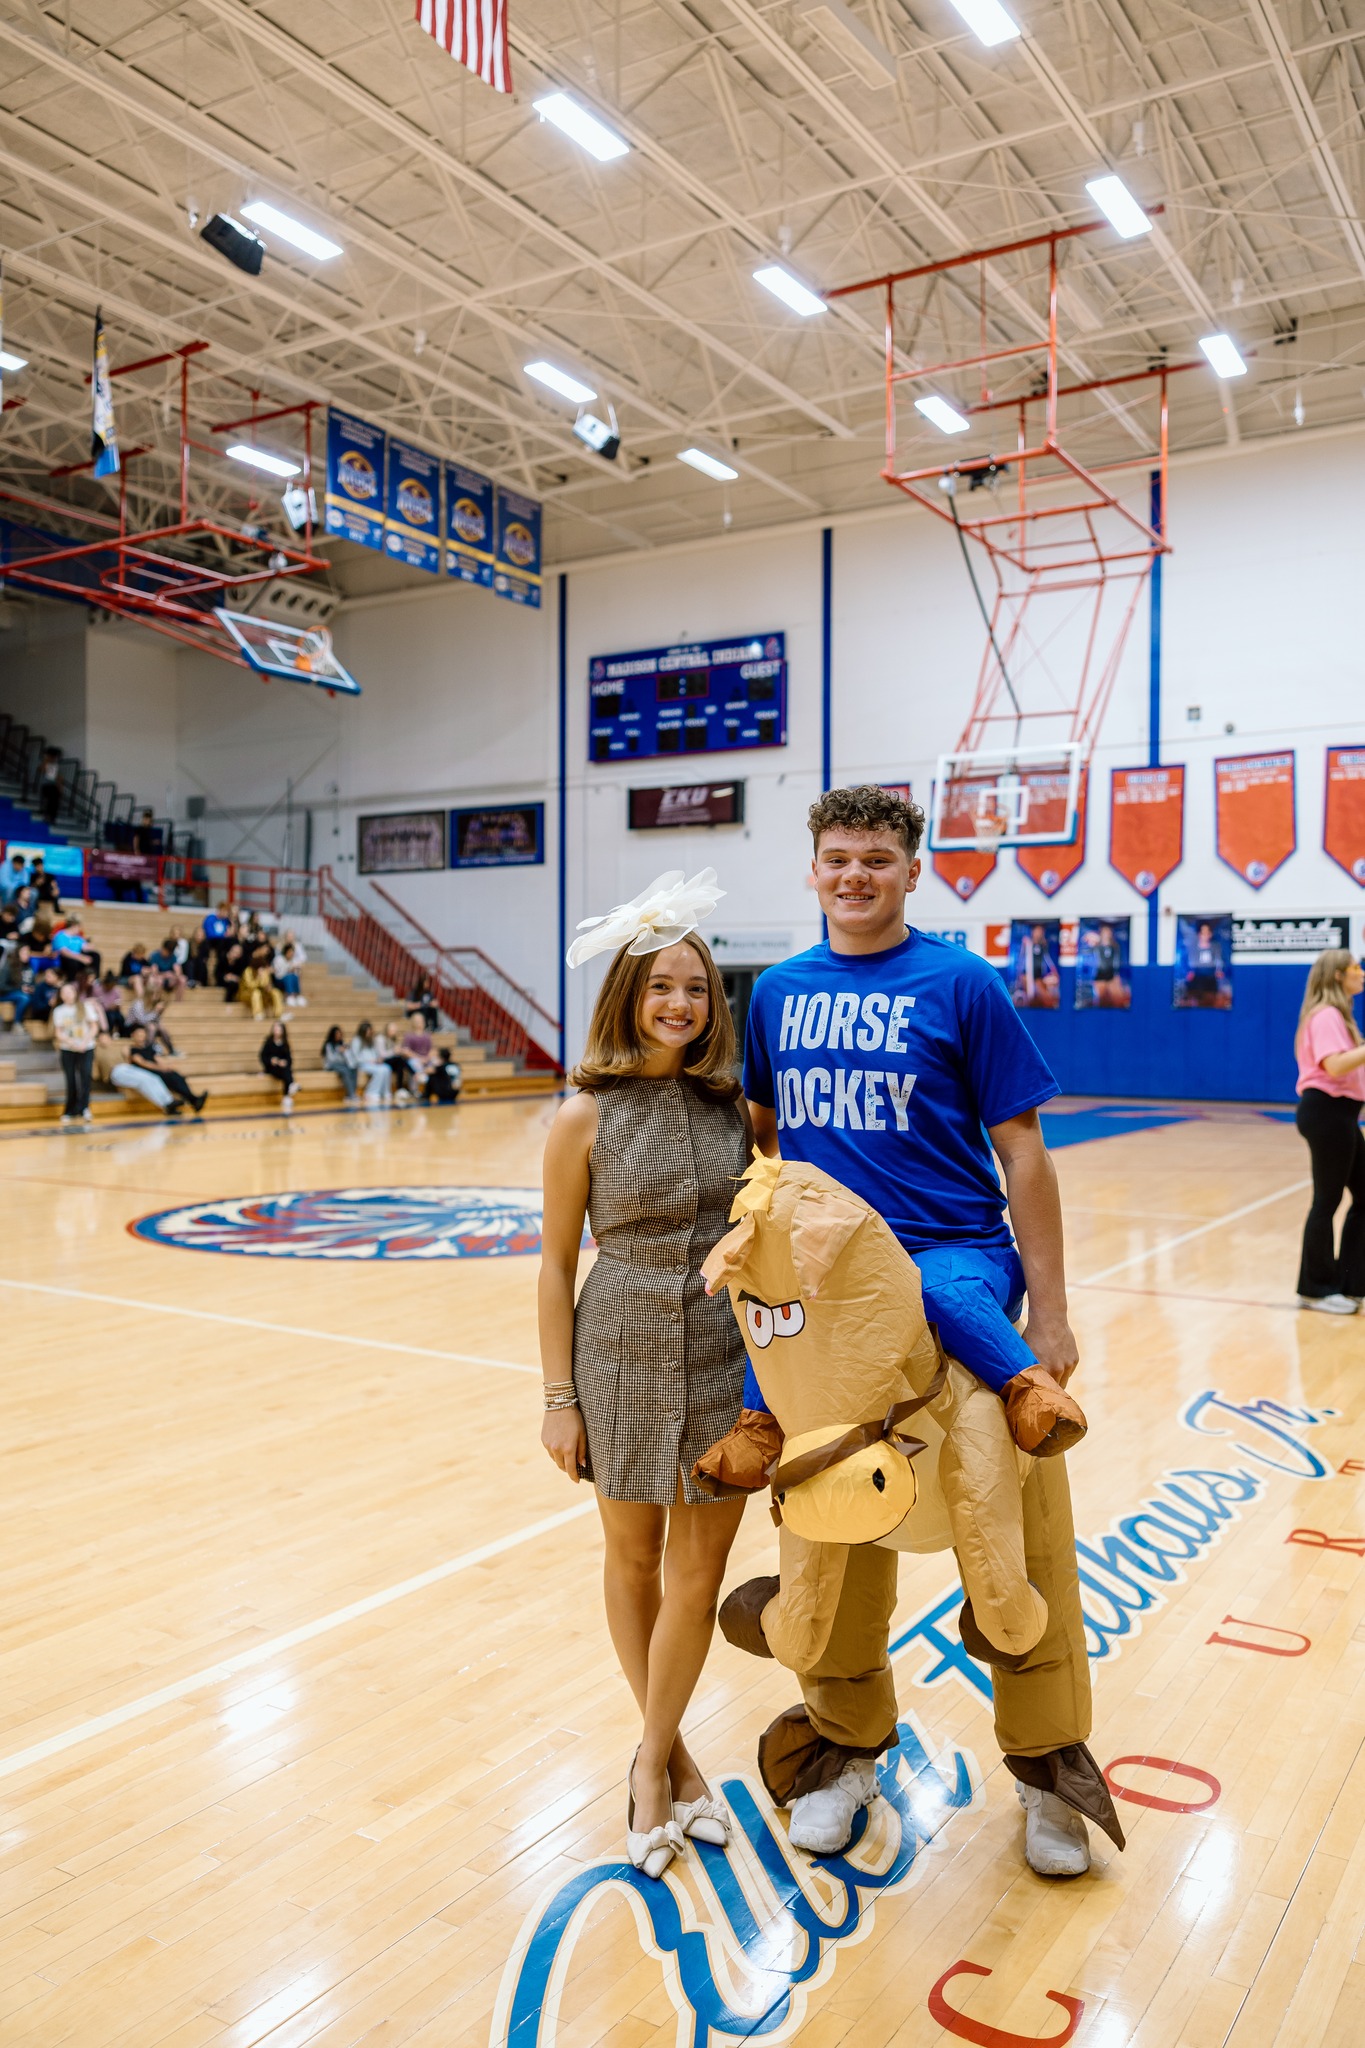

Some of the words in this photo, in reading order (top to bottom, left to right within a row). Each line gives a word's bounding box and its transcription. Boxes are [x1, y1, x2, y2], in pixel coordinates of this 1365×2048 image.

[712, 644, 763, 665] INDIAN
[740, 661, 782, 680] GUEST
[592, 679, 626, 696] HOME
[660, 786, 710, 807] EKU
[779, 992, 916, 1054] HORSE
[777, 1066, 918, 1131] JOCKEY
[1184, 1390, 1336, 1478] Jr.
